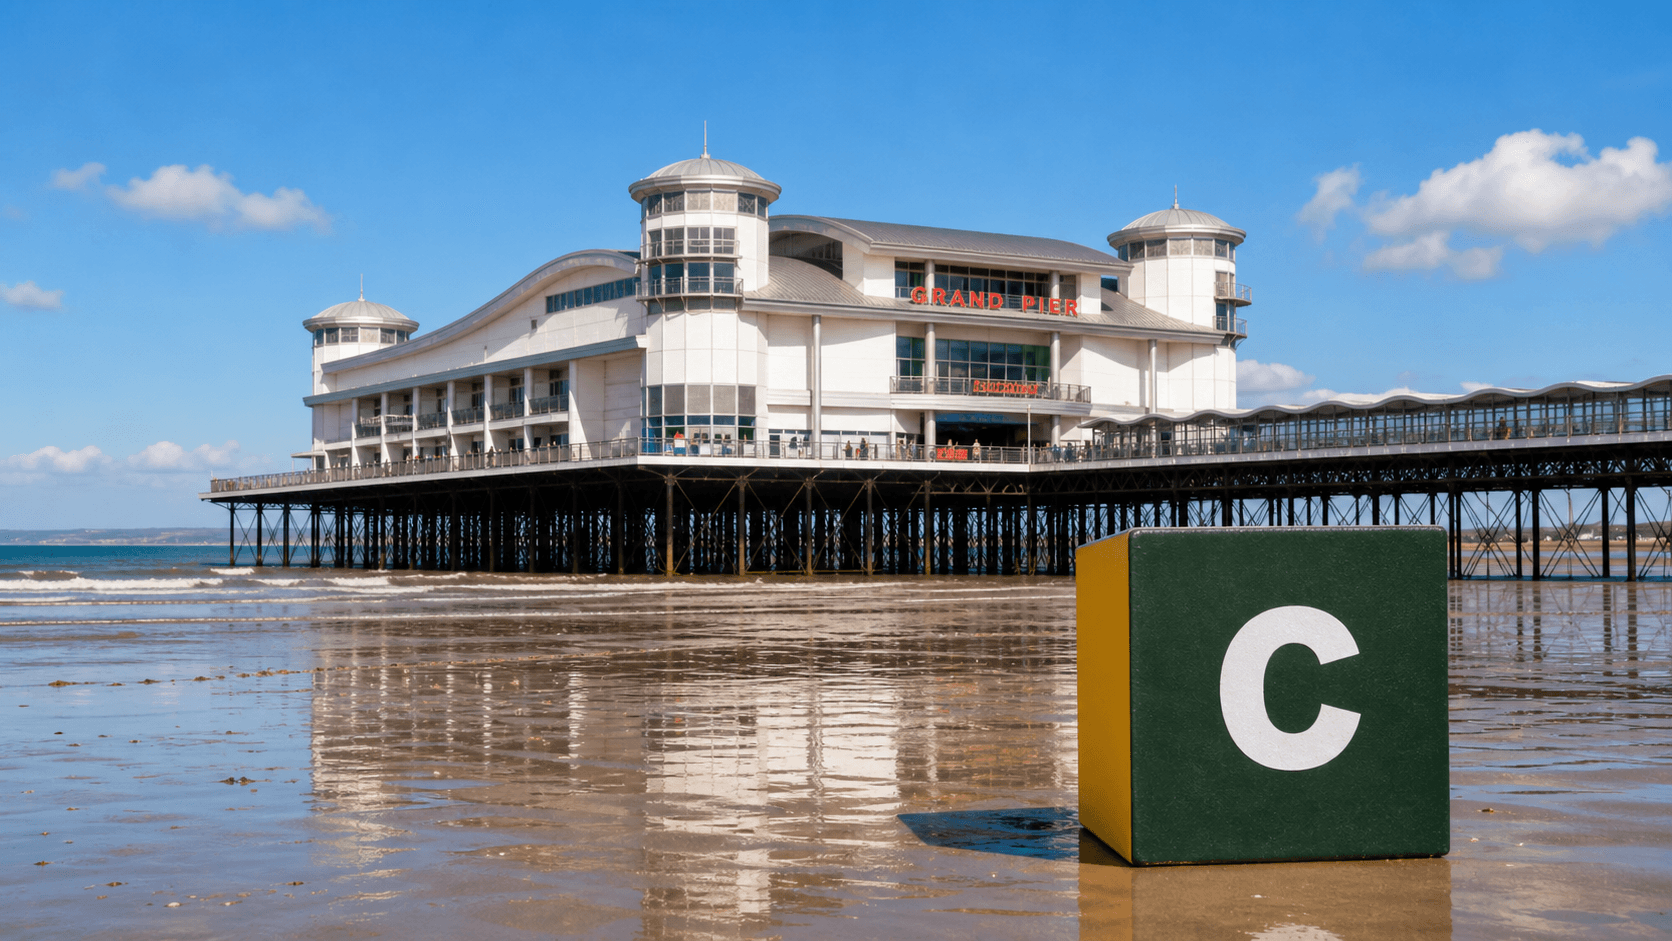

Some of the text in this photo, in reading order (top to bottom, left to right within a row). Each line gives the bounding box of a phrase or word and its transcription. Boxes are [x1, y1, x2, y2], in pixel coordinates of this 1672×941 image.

[911, 286, 1078, 316] GRAND PIER
[1219, 605, 1361, 771] C
